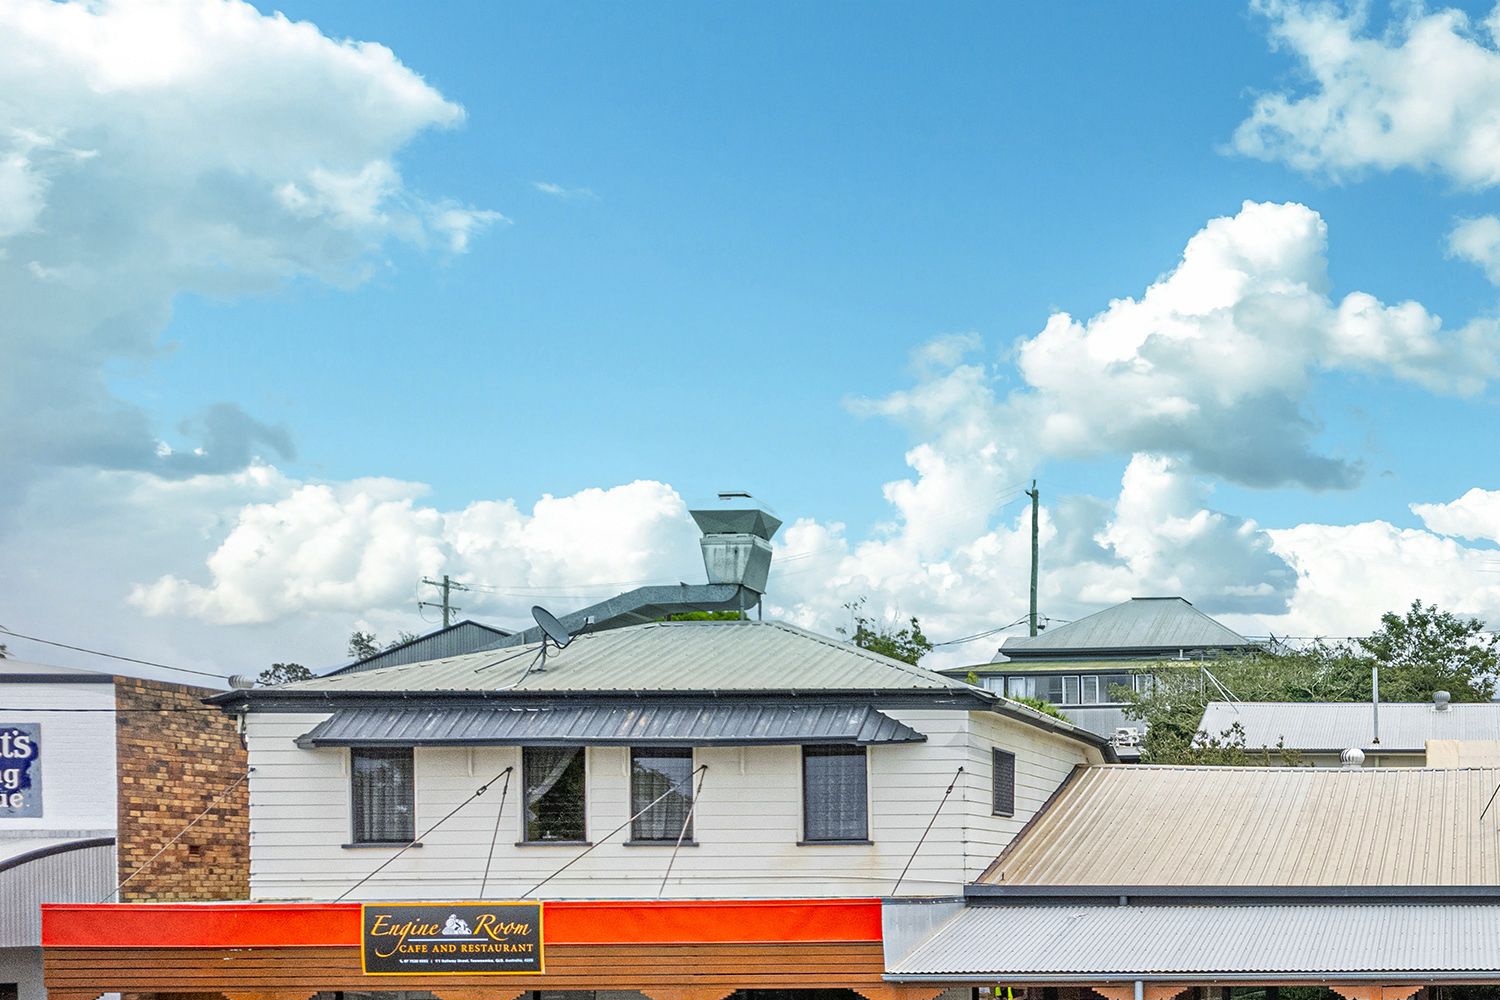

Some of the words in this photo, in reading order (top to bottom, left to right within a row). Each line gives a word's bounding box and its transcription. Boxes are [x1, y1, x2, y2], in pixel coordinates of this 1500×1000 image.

[0, 730, 31, 758] t's
[370, 913, 440, 958] Engine
[473, 913, 532, 942] Room
[399, 943, 428, 954] CAFE
[432, 943, 457, 954] AND
[461, 942, 534, 954] RESTAURANT
